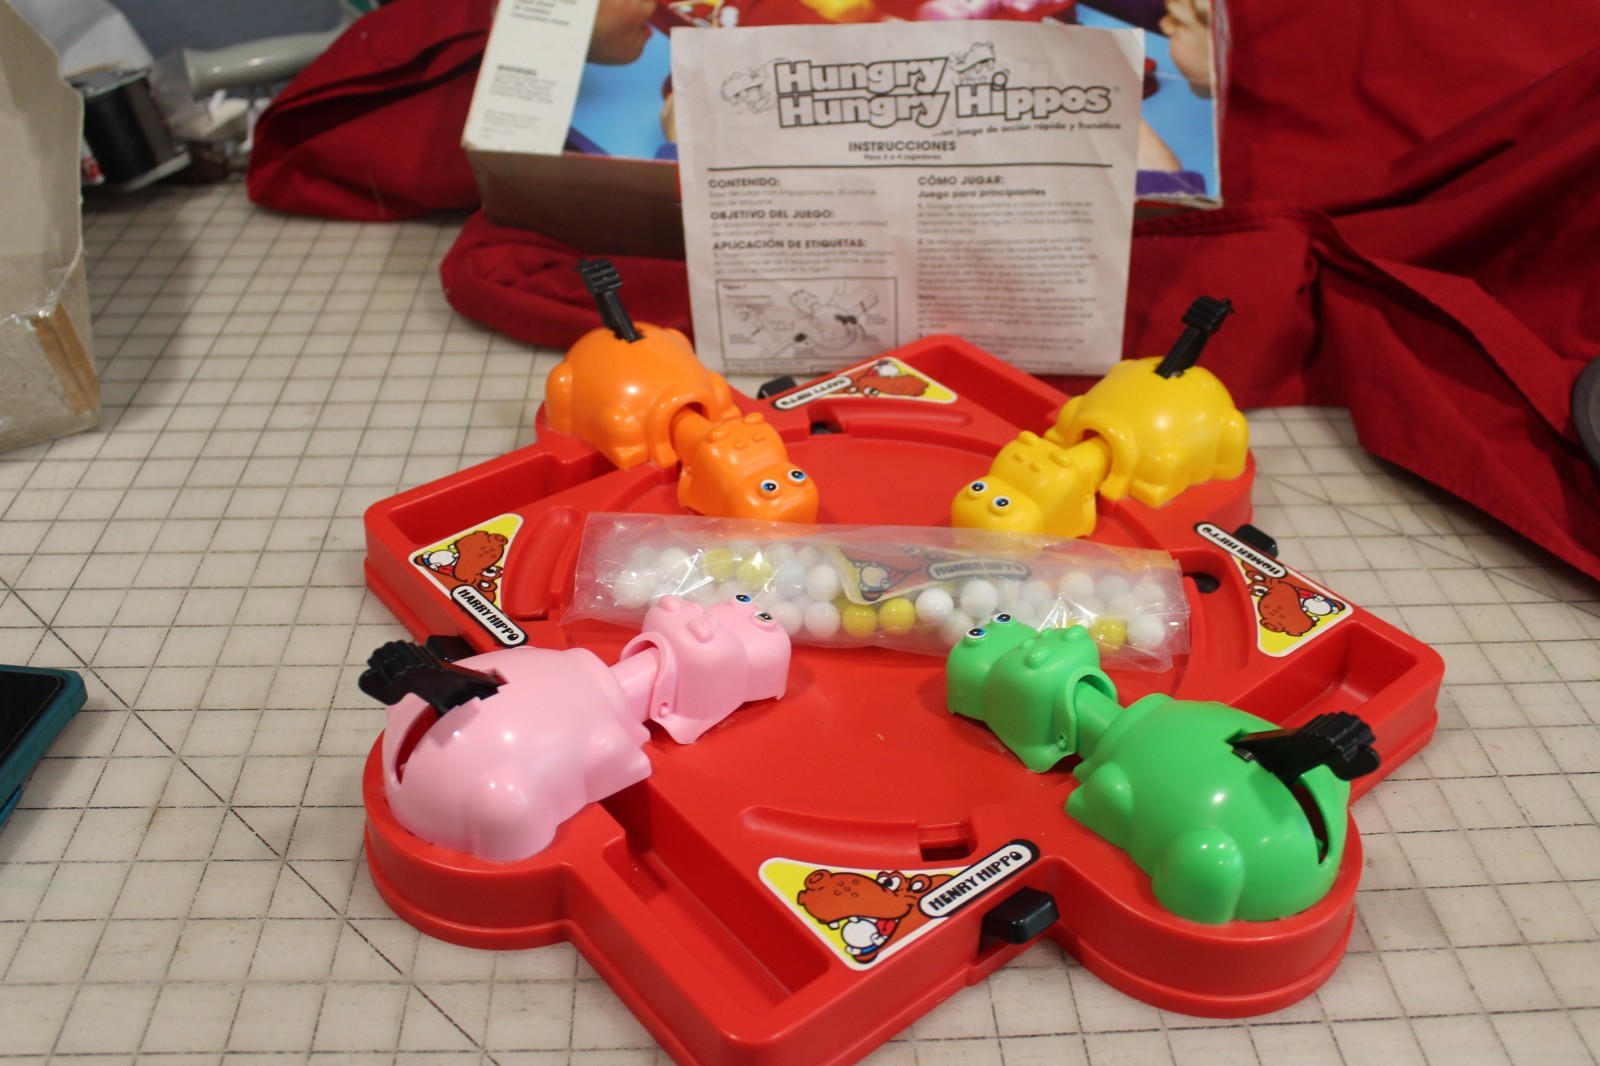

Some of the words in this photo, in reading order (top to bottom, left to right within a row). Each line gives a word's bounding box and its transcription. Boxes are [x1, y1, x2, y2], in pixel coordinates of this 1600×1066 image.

[774, 57, 949, 94] Hungry
[779, 92, 950, 128] Hungry
[956, 72, 1111, 121] Hippos
[987, 124, 998, 133] de
[848, 140, 956, 152] INSTRUCCIONES
[708, 177, 780, 188] CONTENIDO:
[918, 174, 957, 186] CÓMO
[961, 175, 1005, 185] JUGAR:
[918, 190, 949, 200] Juego
[952, 190, 977, 198] para
[979, 187, 1046, 198] principiantes
[710, 209, 766, 220] OBJETIVO
[768, 209, 788, 218] DEL
[793, 208, 835, 218] JUEGO:
[713, 238, 784, 250] APLICACIÓN
[787, 239, 801, 248] DE
[804, 238, 867, 248] ETIQUETAS:
[1202, 527, 1238, 549] HIPPO
[1236, 548, 1281, 574] HOMER
[457, 589, 493, 617] HARRY
[487, 614, 520, 641] HIPPO
[928, 876, 978, 911] HENRY
[976, 851, 1022, 883] HIPPO
